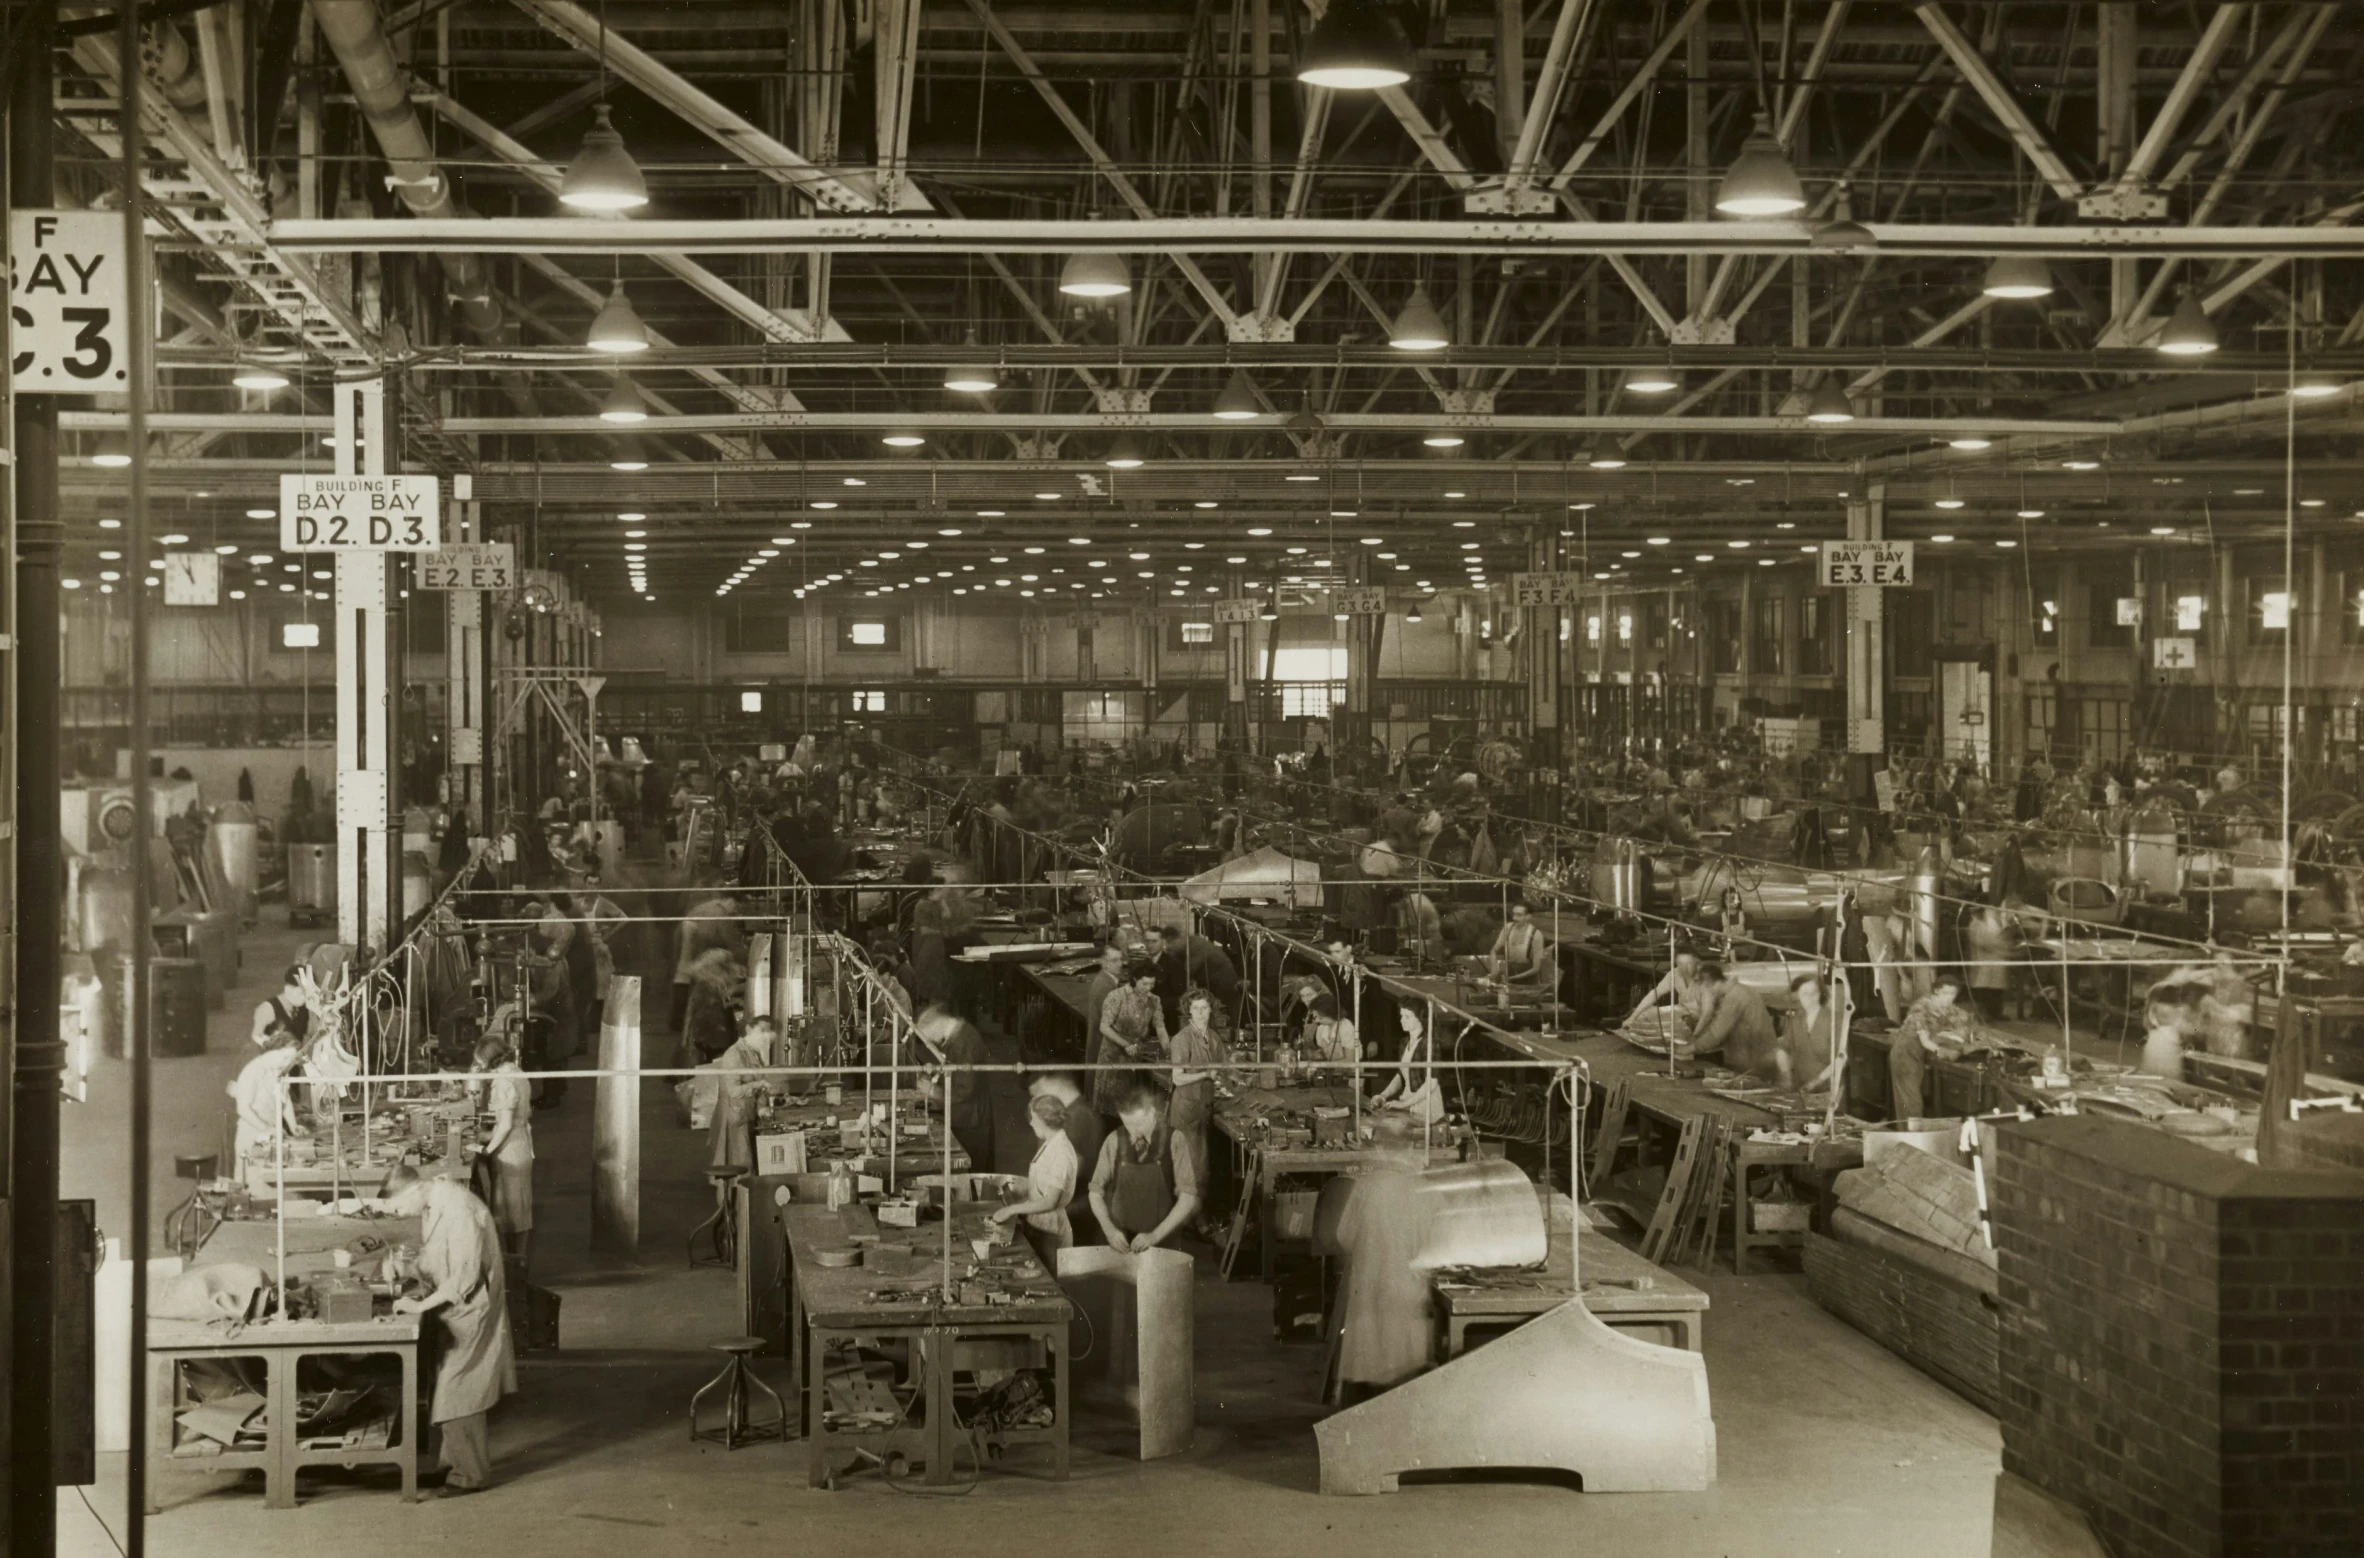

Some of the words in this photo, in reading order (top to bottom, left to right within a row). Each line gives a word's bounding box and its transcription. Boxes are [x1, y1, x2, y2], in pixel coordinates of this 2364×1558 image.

[34, 216, 58, 248] F
[316, 480, 384, 492] BUILDING
[392, 479, 402, 491] F
[297, 494, 345, 510] BAY
[371, 494, 420, 510] BAY
[296, 515, 357, 545] D.2.
[369, 516, 431, 545] D.3.
[425, 554, 457, 565] BAY
[472, 554, 503, 565] BAY
[1831, 551, 1861, 562] BAY
[1874, 551, 1904, 562] BAY
[425, 568, 464, 588] E.2.
[471, 568, 511, 588] E.3.
[1830, 564, 1867, 584] E.3.
[1873, 564, 1910, 584] E.4.
[1519, 580, 1540, 588] BAY
[1362, 592, 1380, 600] BAY
[944, 1326, 959, 1335] 70
